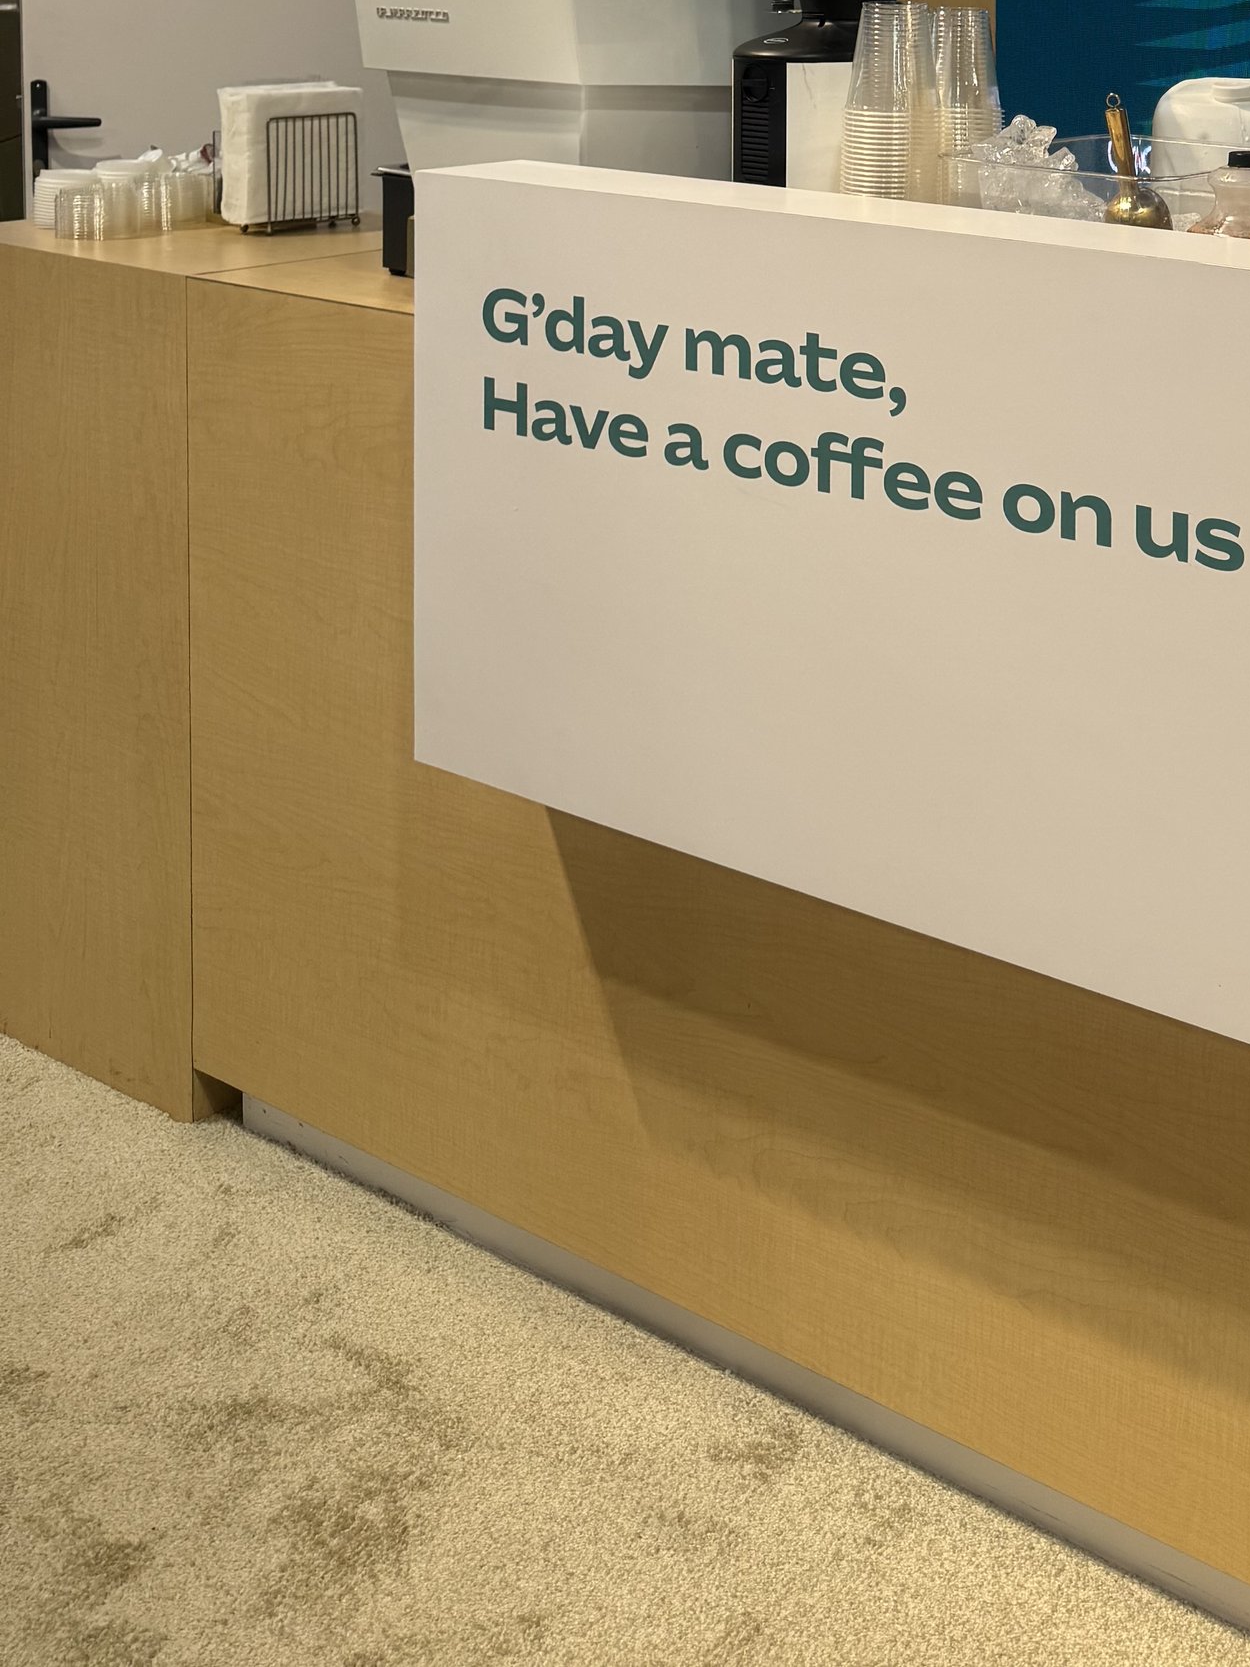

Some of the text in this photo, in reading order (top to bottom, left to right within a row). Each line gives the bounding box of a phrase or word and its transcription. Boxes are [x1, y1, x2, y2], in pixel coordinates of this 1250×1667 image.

[483, 289, 907, 417] G’day mate,
[483, 377, 1245, 572] Have a coffee on us
